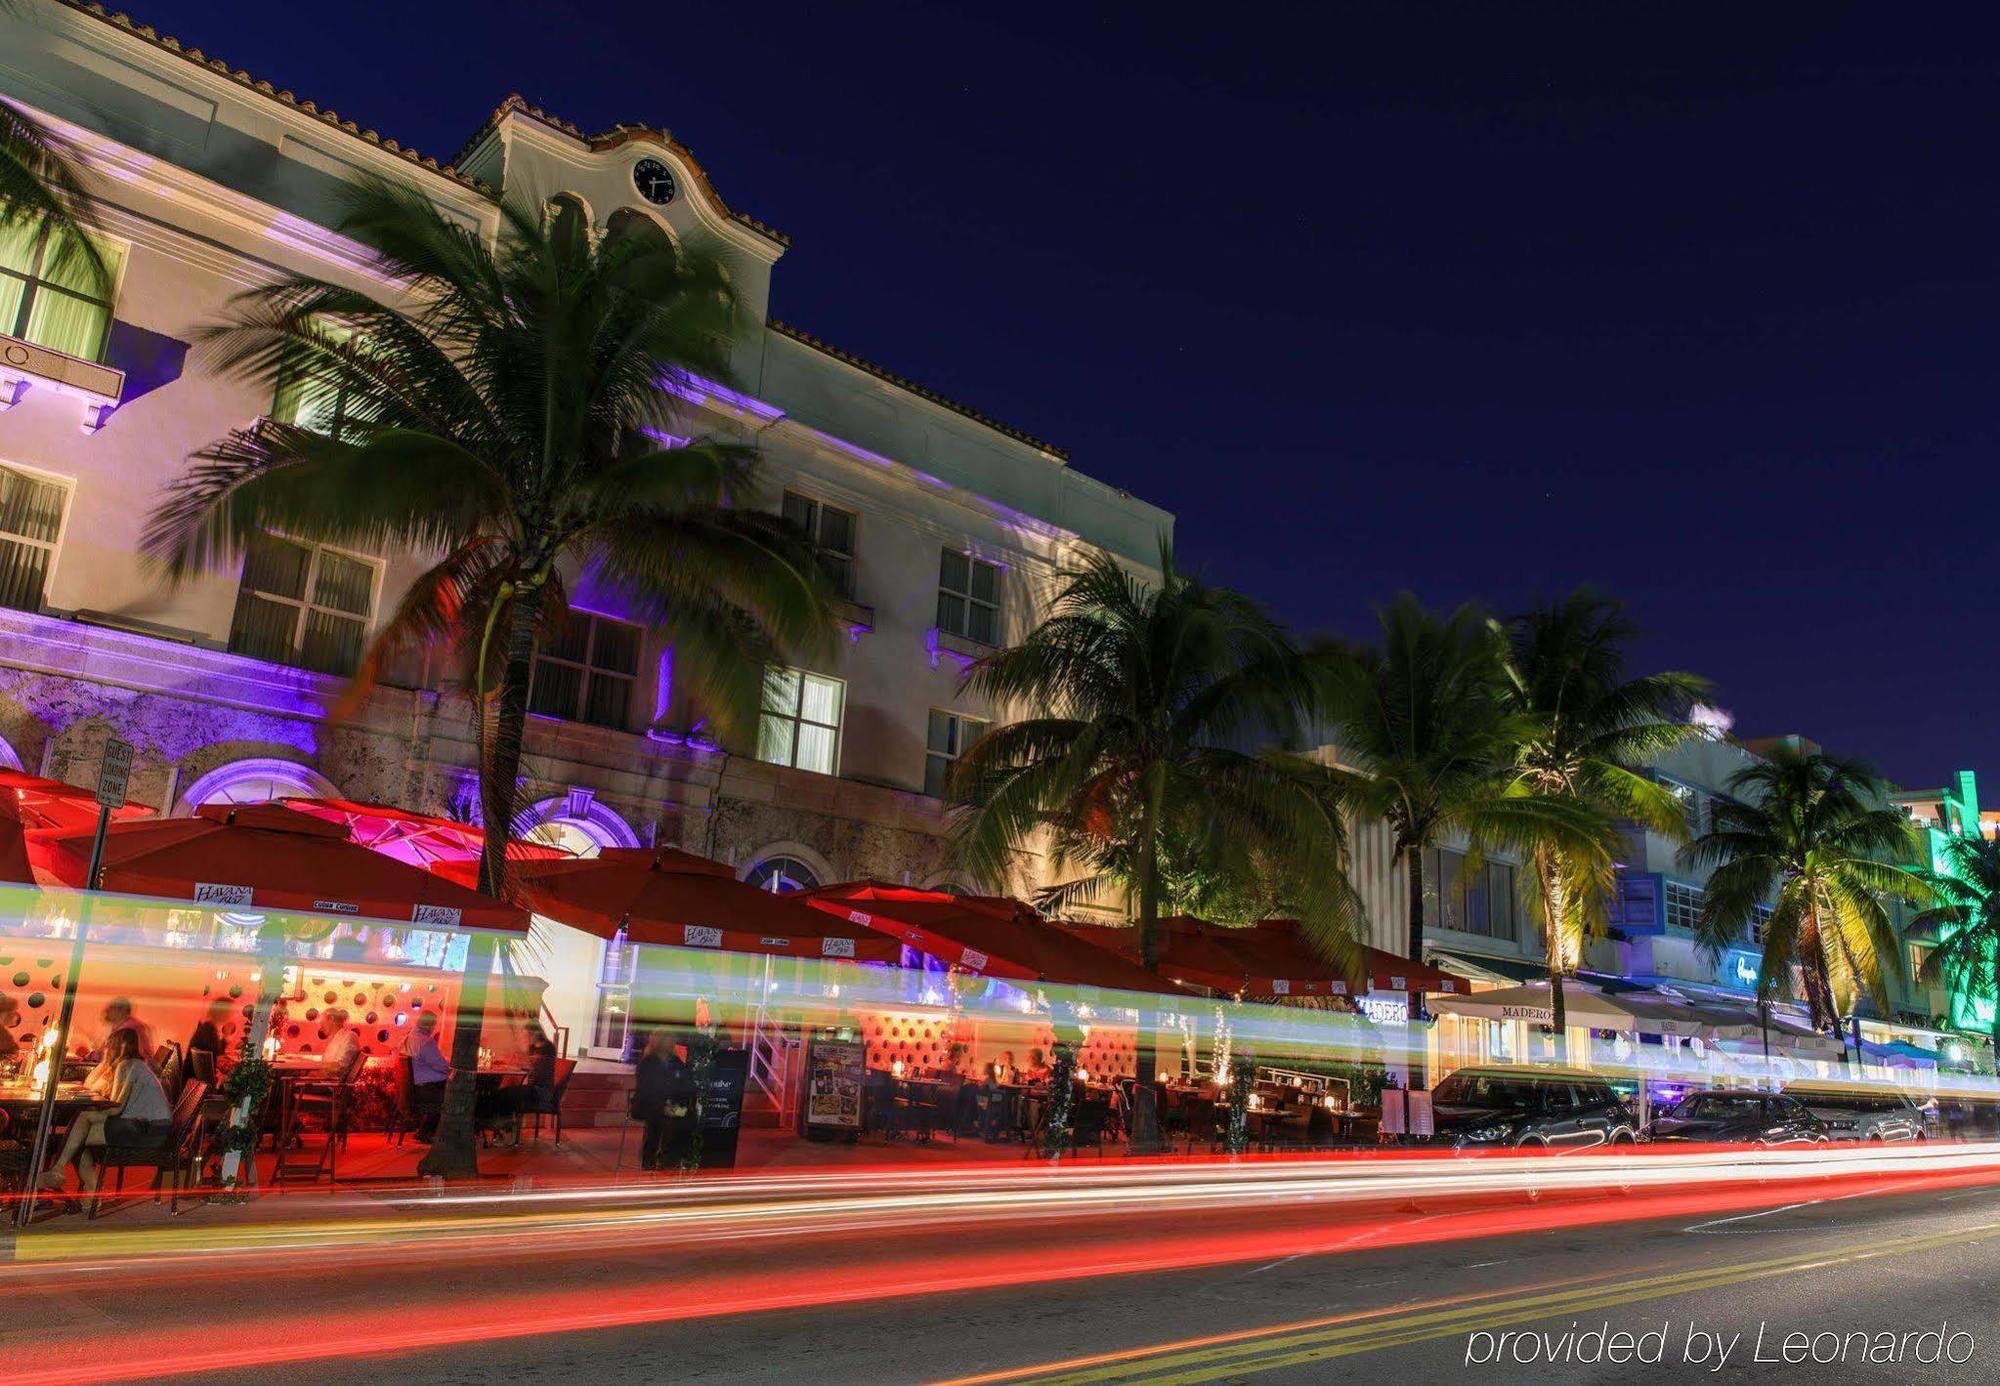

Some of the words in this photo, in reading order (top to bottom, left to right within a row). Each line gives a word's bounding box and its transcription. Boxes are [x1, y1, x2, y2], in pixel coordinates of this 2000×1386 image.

[107, 745, 131, 763] GUEST
[104, 762, 128, 779] LOADING
[102, 779, 123, 796] ZONE
[196, 884, 252, 903] HAVANA
[413, 904, 460, 923] HAVANA
[1502, 1006, 1551, 1020] MADERO
